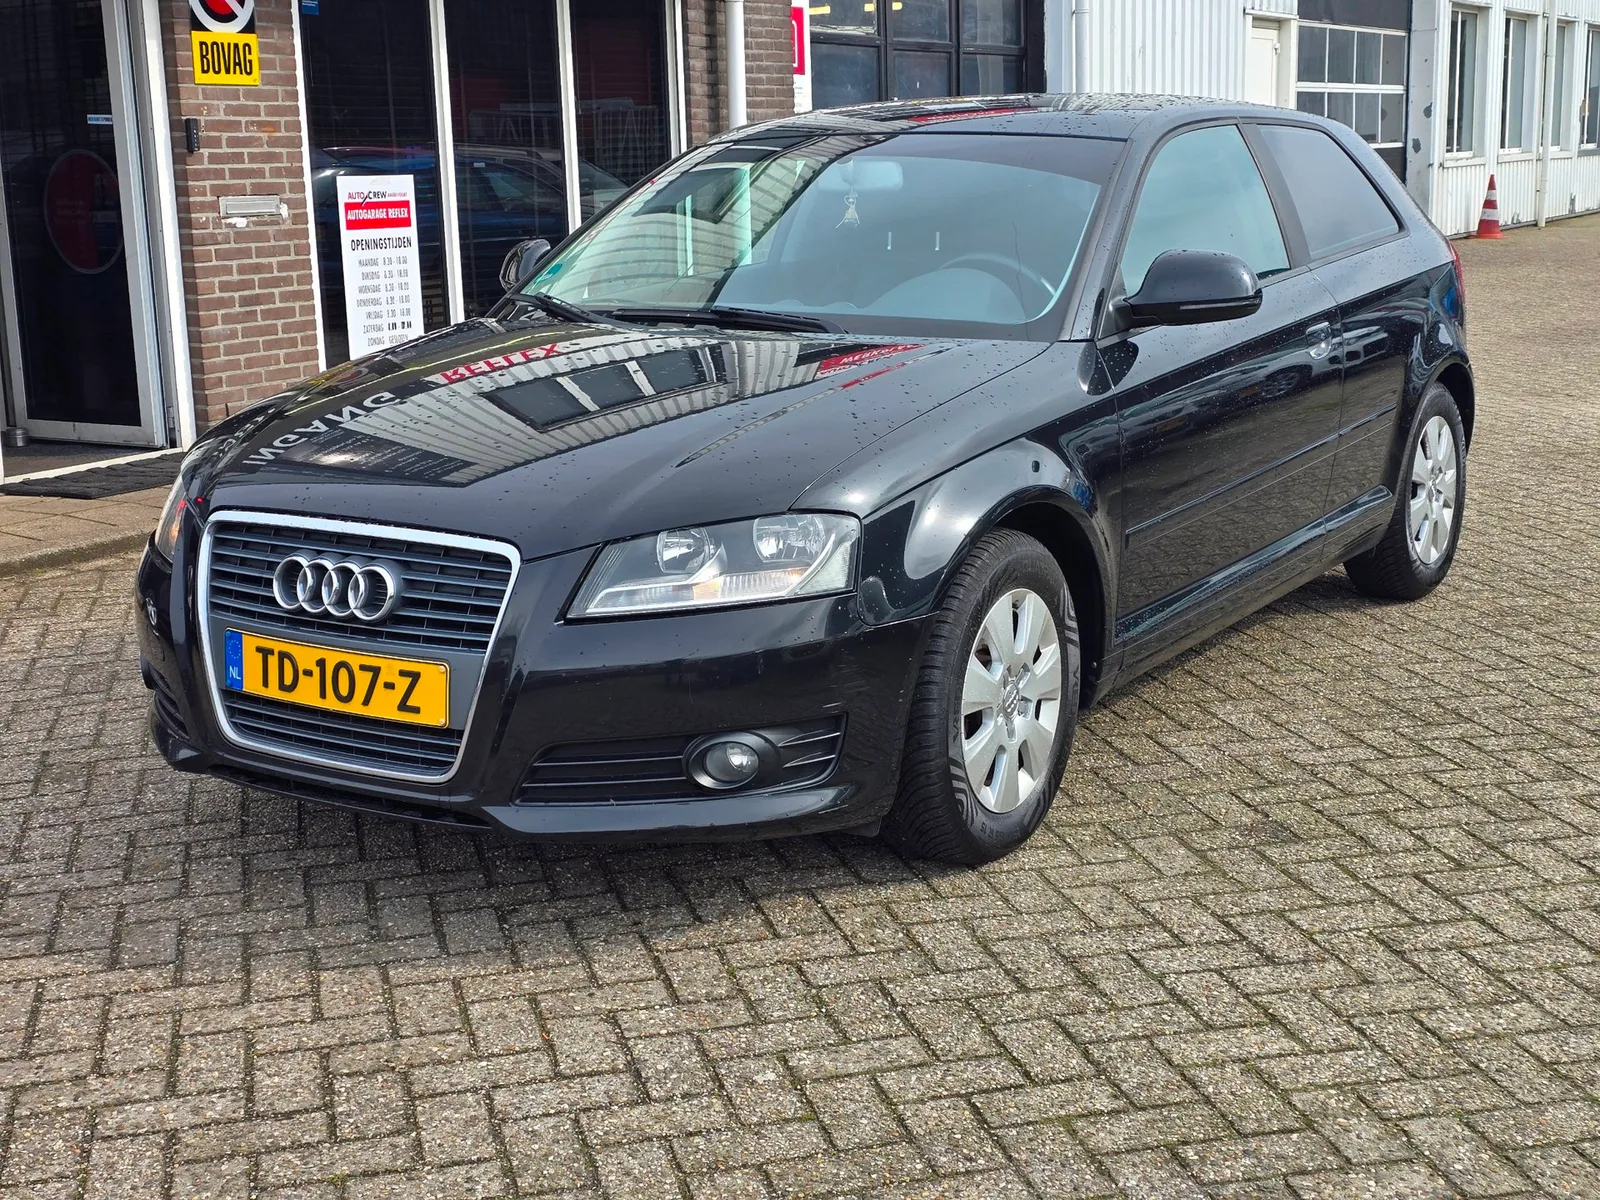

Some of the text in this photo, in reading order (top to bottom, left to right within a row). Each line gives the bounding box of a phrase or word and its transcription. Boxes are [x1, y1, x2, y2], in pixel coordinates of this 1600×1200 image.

[199, 40, 254, 76] BOVAG
[367, 190, 387, 200] CREW
[347, 207, 409, 220] AUTOGARAGE REFLEX
[350, 236, 412, 251] OPENINGSTIJDEN
[229, 666, 241, 680] NL
[255, 646, 421, 714] TD-107-Z
